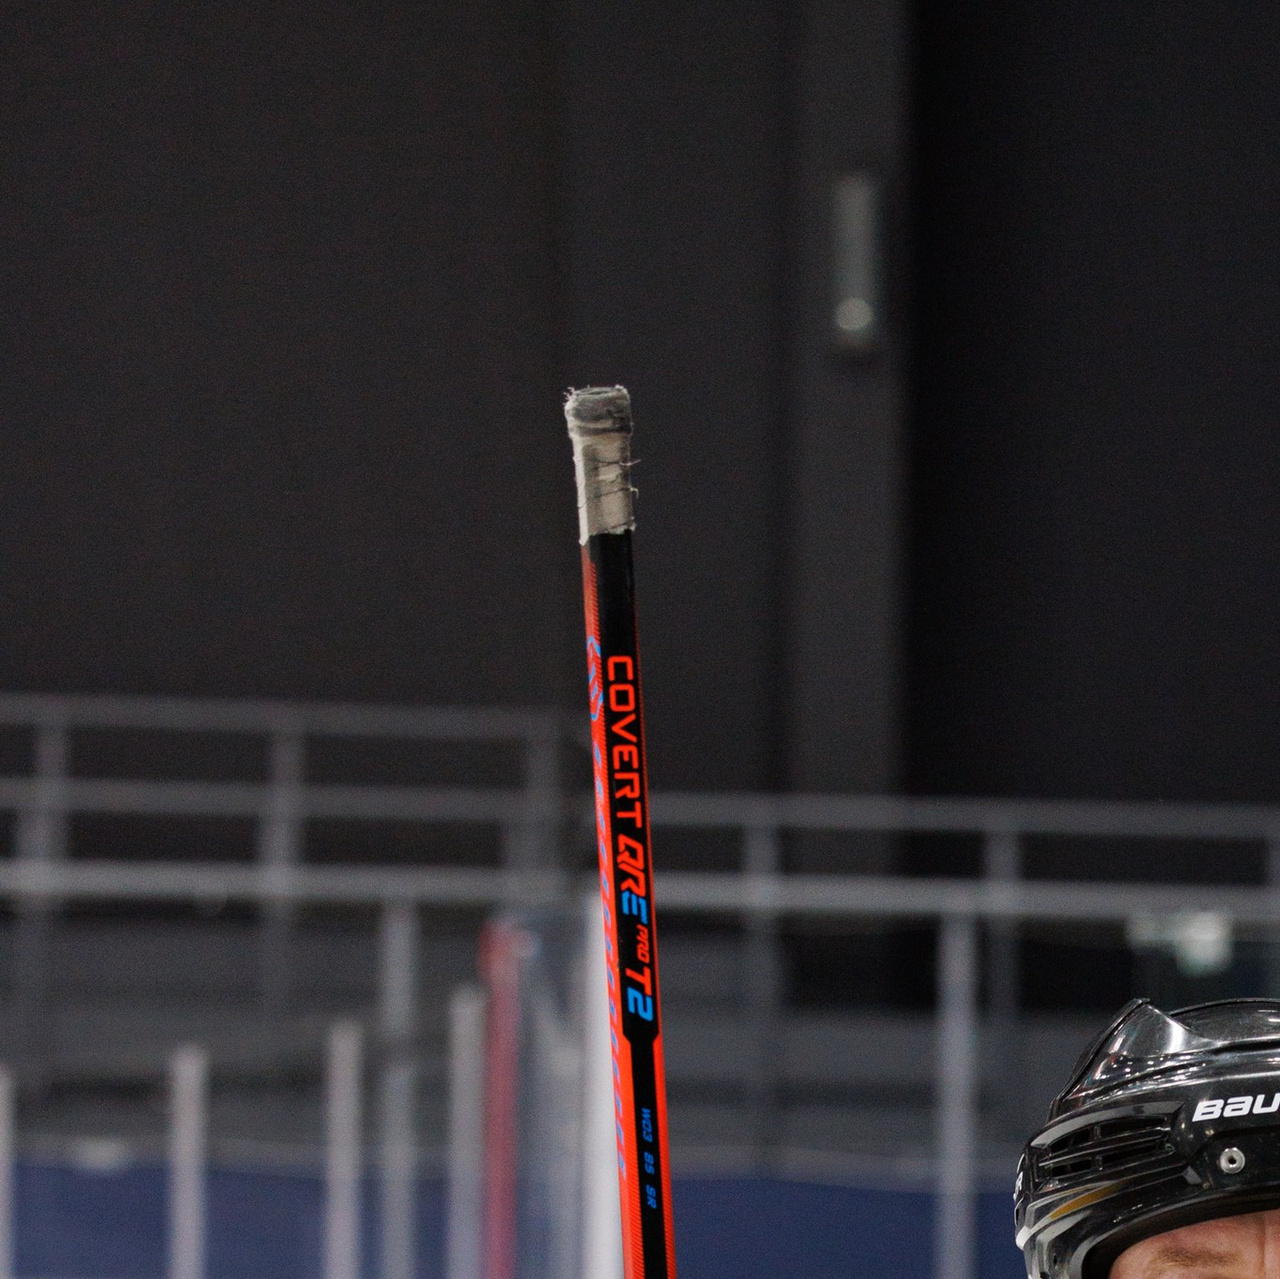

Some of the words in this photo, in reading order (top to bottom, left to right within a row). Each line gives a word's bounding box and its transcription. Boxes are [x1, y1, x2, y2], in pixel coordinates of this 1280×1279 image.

[607, 655, 643, 829] COVERT
[636, 925, 651, 965] PRO
[625, 965, 654, 1022] T2
